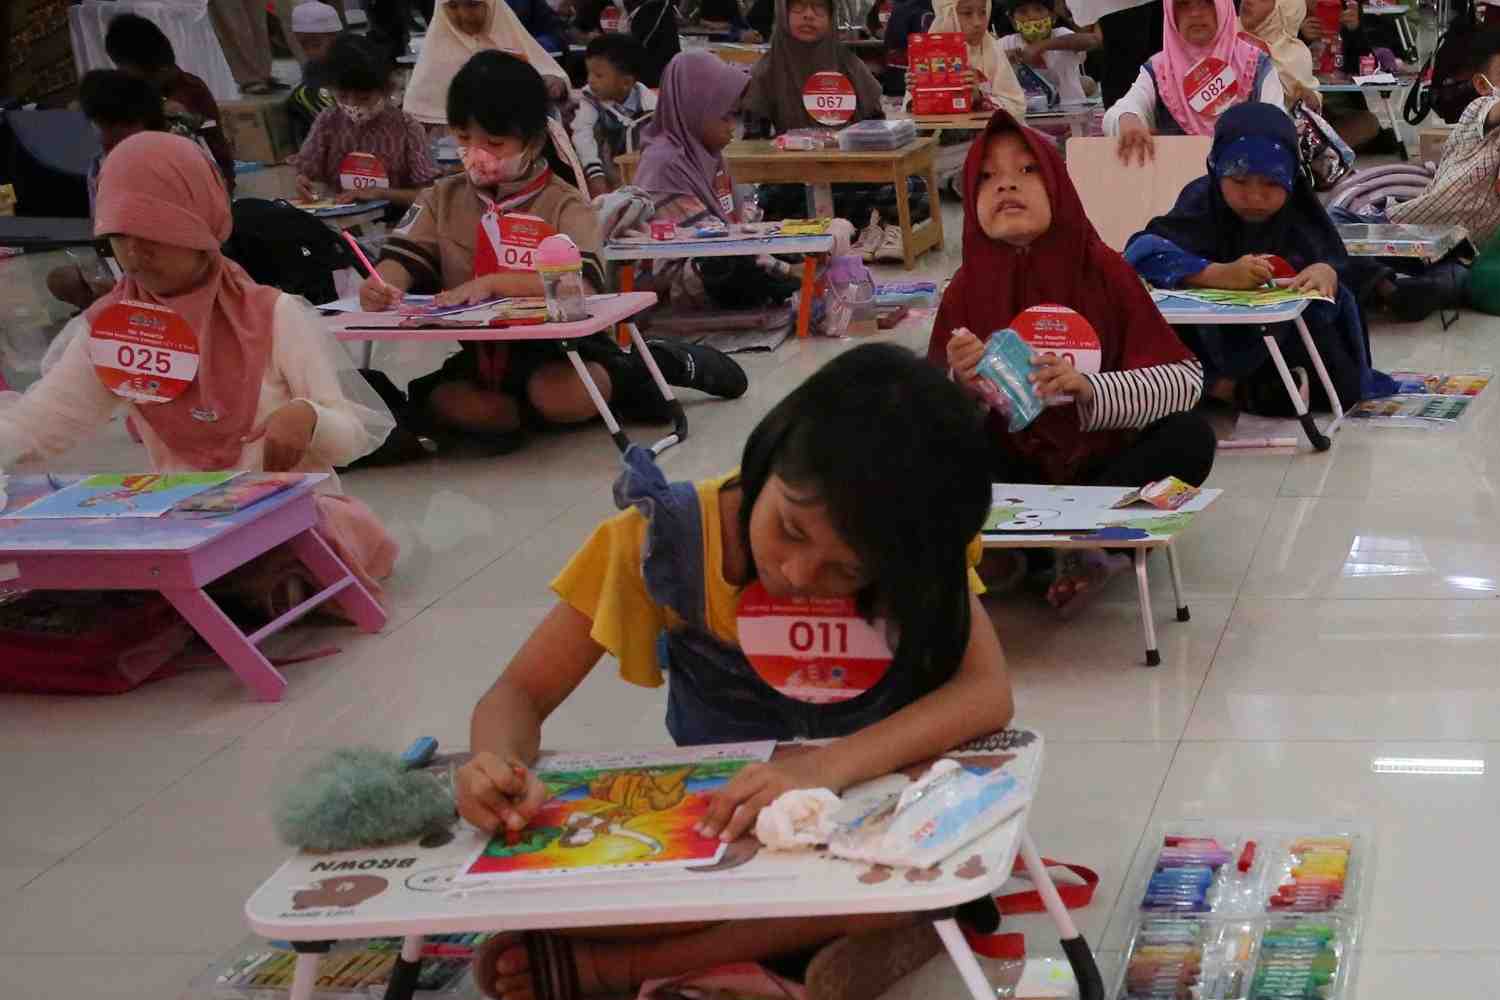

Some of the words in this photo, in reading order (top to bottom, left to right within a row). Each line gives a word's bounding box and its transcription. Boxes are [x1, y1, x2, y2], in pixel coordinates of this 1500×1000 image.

[1201, 77, 1225, 101] 082
[816, 97, 843, 108] 067
[504, 249, 533, 267] 04
[117, 346, 171, 373] 025
[789, 622, 848, 652] 011
[310, 858, 417, 872] BROWN
